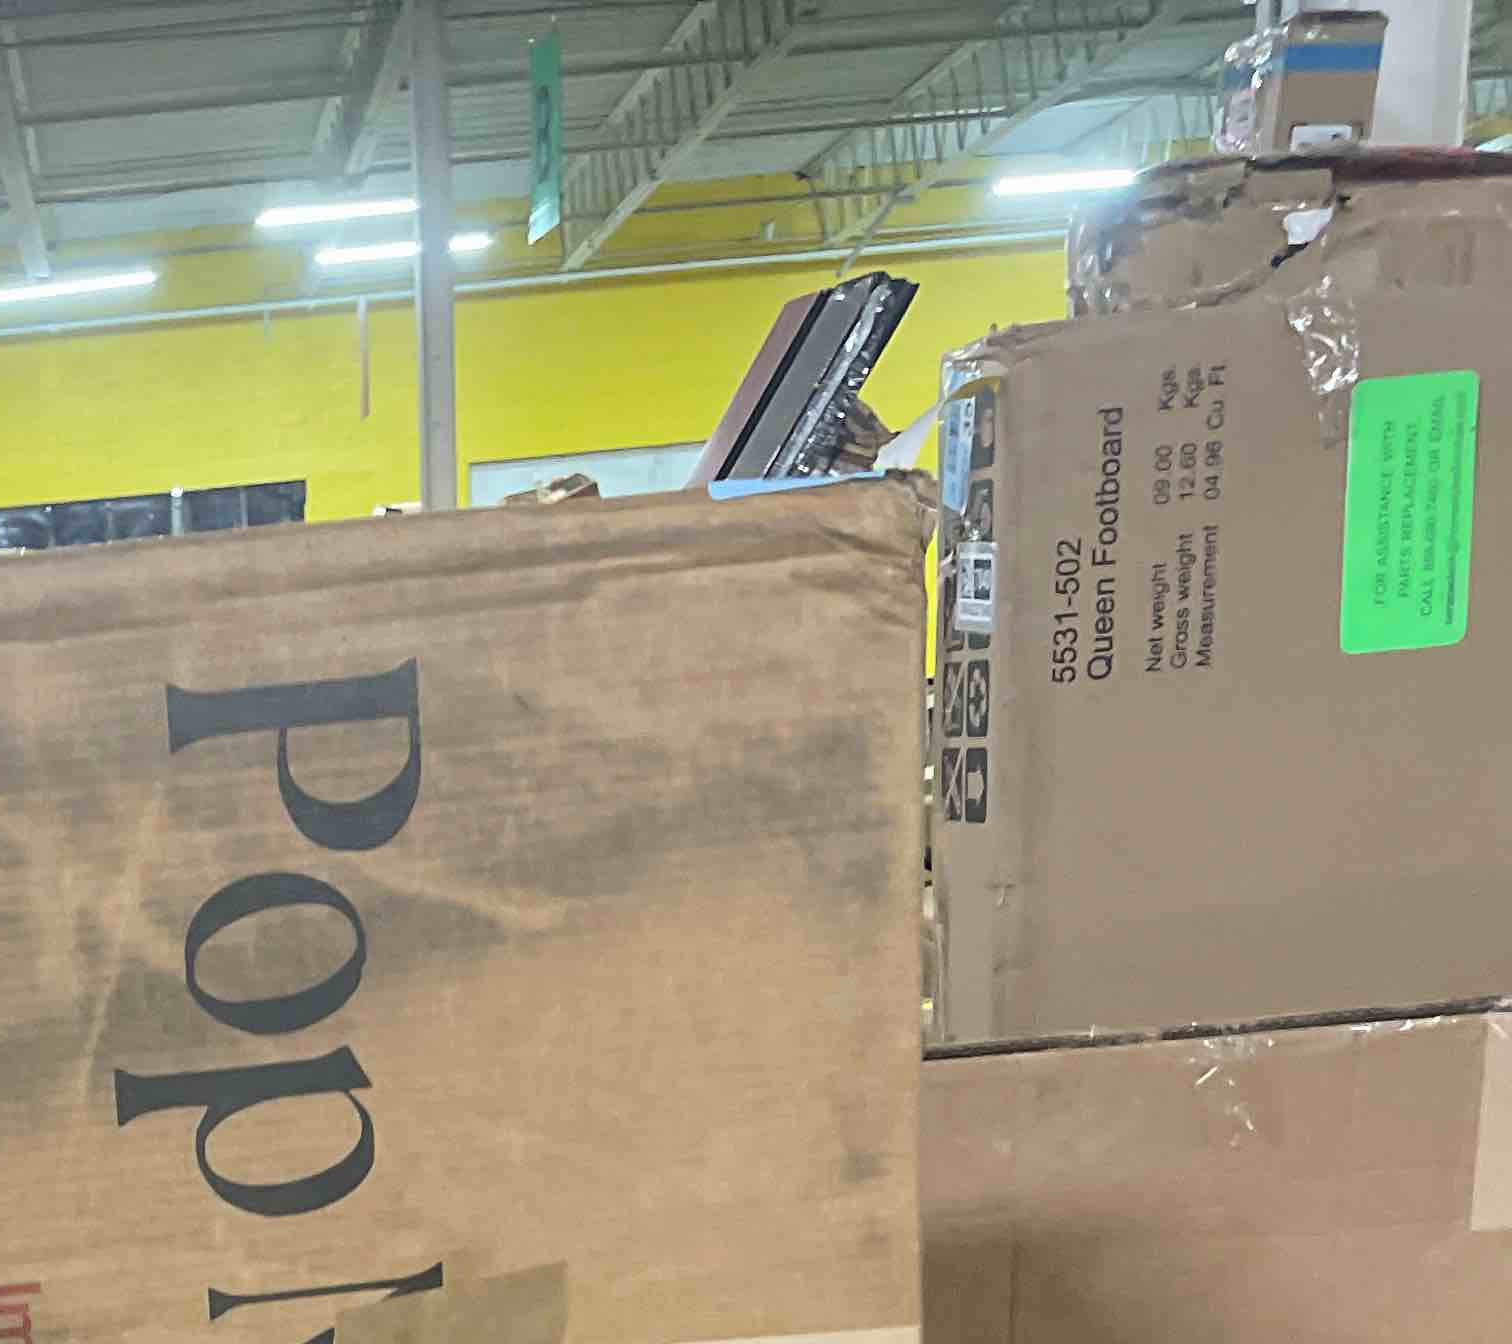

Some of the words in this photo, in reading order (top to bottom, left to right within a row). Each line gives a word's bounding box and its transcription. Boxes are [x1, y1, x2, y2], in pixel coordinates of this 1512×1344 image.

[1091, 406, 1123, 567] Footboard
[1150, 562, 1169, 631] weight
[1176, 533, 1197, 600] weight
[1195, 525, 1219, 668] Measurement
[1051, 537, 1082, 683] 5531-502
[1086, 577, 1115, 681] Queen
[1170, 607, 1190, 670] Gross
[1144, 637, 1164, 672] Net
